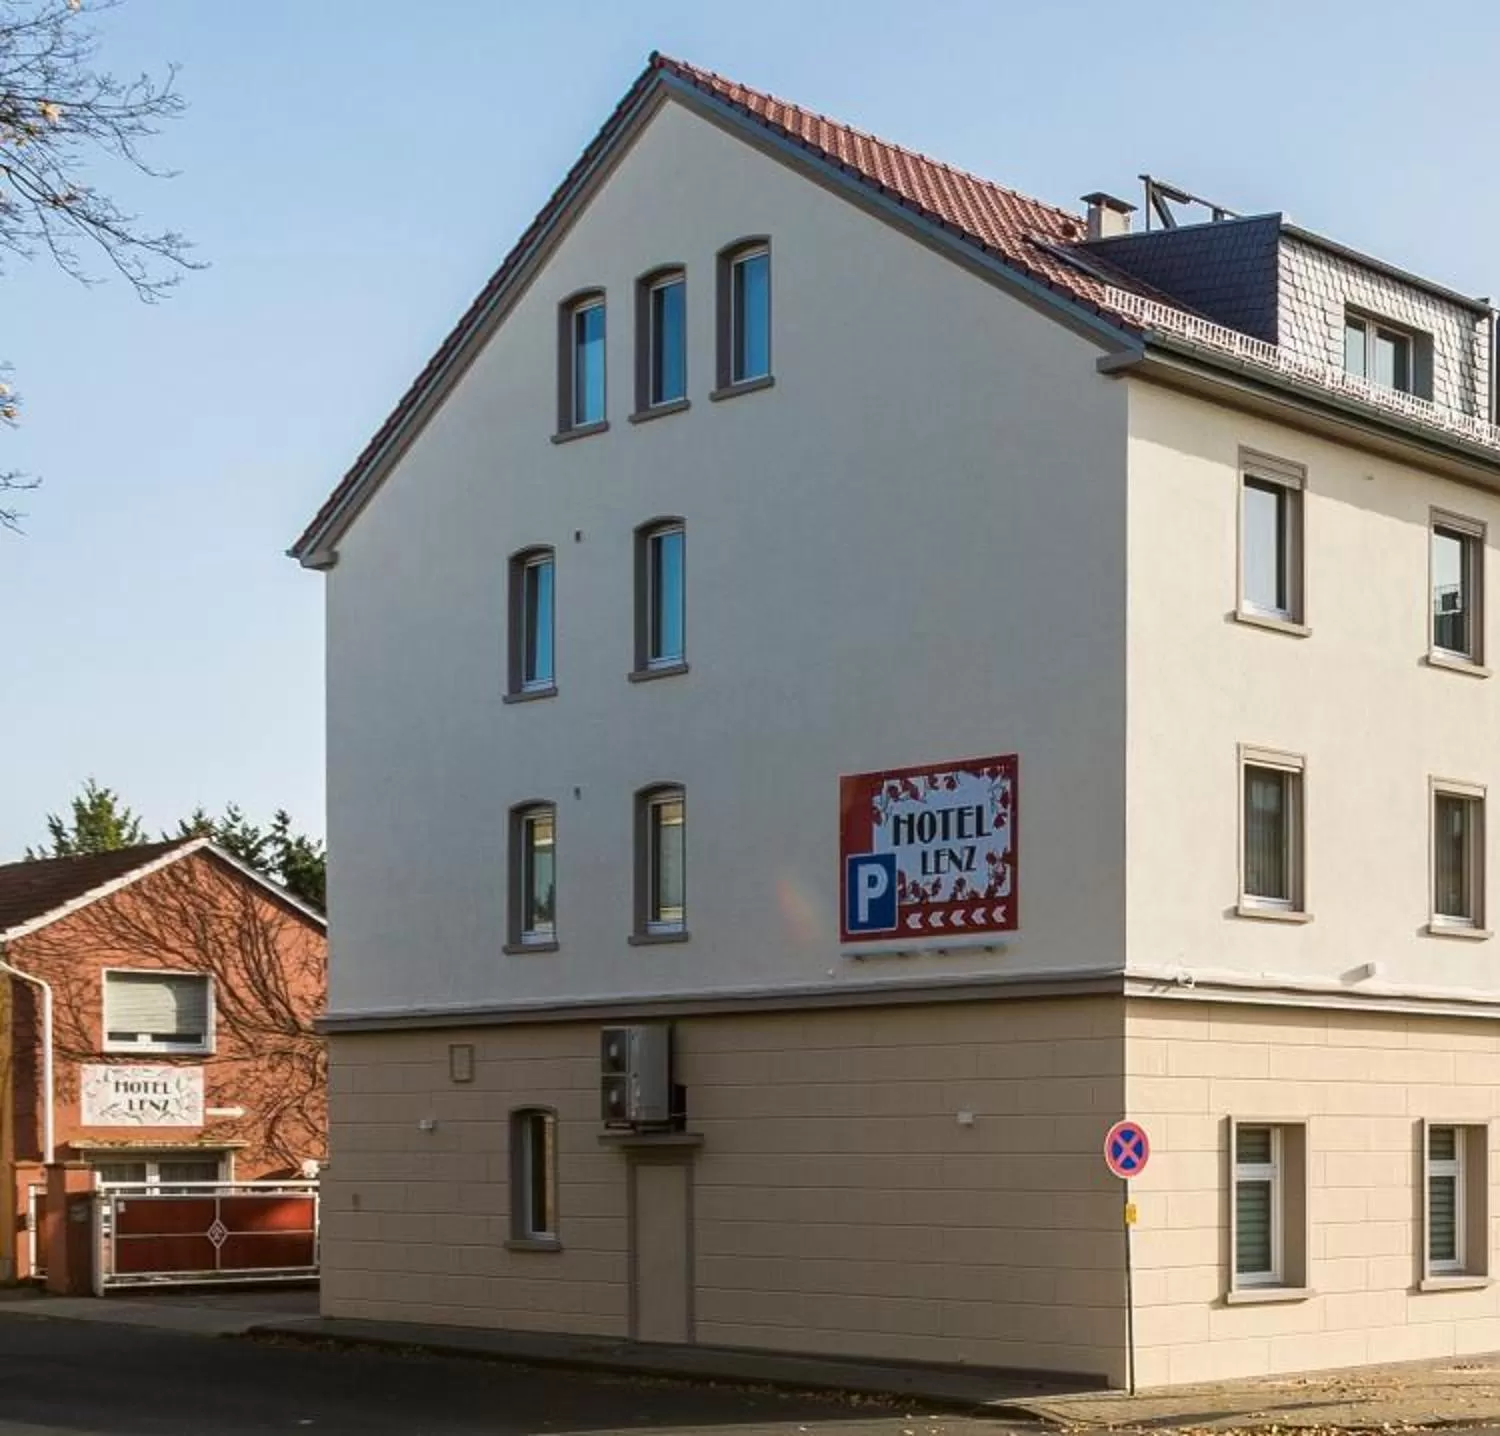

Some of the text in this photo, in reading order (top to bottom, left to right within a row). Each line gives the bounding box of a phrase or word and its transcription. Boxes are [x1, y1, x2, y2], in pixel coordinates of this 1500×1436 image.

[892, 805, 993, 846] HOTEL
[921, 845, 977, 876] LENZ
[857, 864, 889, 923] P
[114, 1080, 171, 1095] HOTEL
[128, 1099, 169, 1111] LENZ
